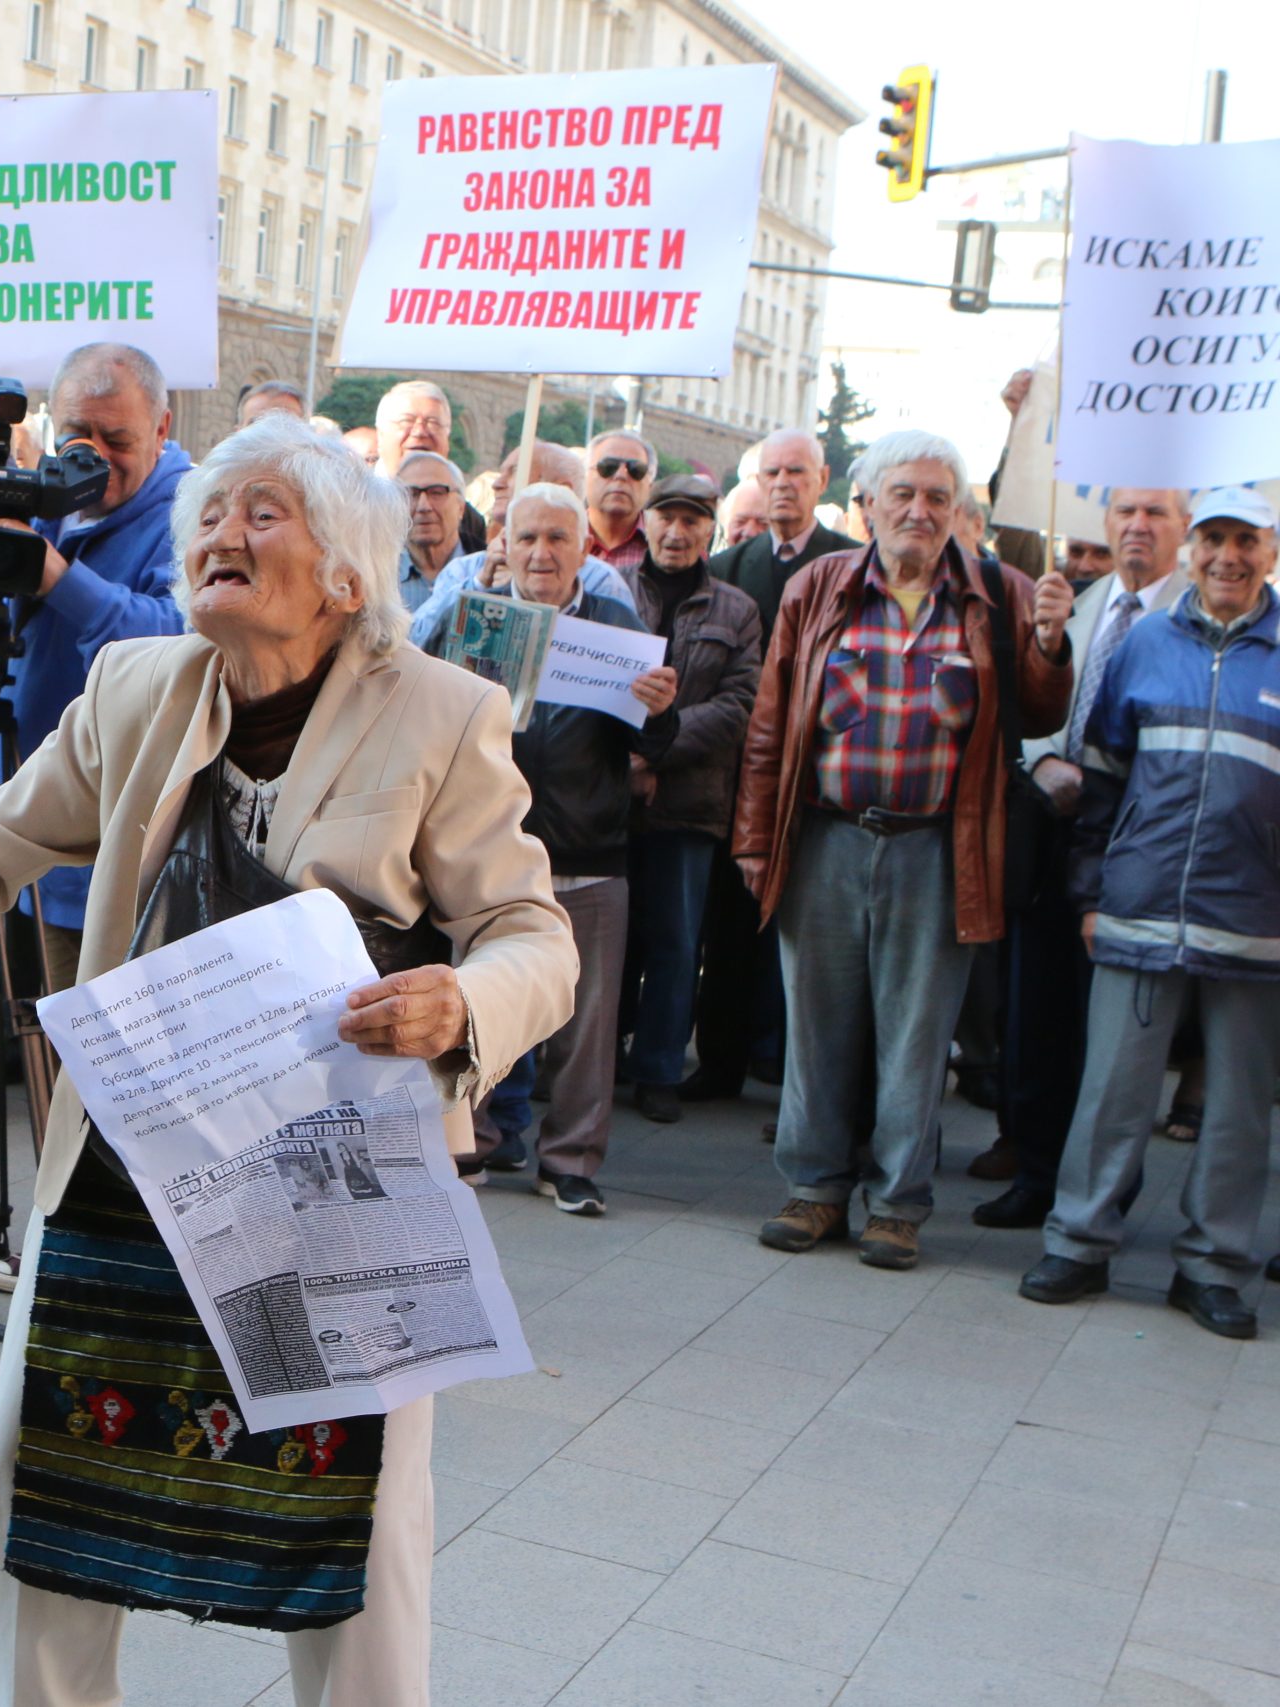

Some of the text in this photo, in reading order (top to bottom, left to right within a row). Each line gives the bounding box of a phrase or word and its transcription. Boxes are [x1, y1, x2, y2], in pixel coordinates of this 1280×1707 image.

[416, 103, 723, 154] РАВЕНСТВО ПРЕД
[463, 166, 651, 212] ЗАКОНА ЗА
[419, 228, 686, 277] ГРАЖДАНИТЕ И
[1083, 234, 1264, 269] ИСКАМЕ
[384, 287, 702, 337] УПРАВЛЯВАЩИТЕ
[1151, 284, 1280, 318] КОИТ
[1131, 333, 1280, 366] ОСИГУ
[1075, 378, 1278, 416] ДОСТОЕН
[550, 639, 651, 673] РЕИЗЧИСЛЕТЕ
[71, 951, 234, 1030] Депутатите 160 в парламента
[80, 958, 284, 1049] Искаме магазини за пенсионерите с
[90, 1021, 187, 1067] хранителни стоки
[101, 981, 347, 1087] Субсидиите за депутатите от 12лв. да станат
[111, 1092, 126, 1103] на
[127, 1086, 150, 1099] 2лв.
[151, 1067, 195, 1092] Другите
[195, 1059, 211, 1072] 10
[219, 1051, 233, 1062] за
[234, 1014, 313, 1054] пенсионерите
[122, 1061, 259, 1125] Депутатите до 2 мандата
[134, 1041, 340, 1138] Който иска да го избират да си плаща
[336, 1107, 362, 1119] НА
[292, 1121, 363, 1138] метлата
[167, 1174, 214, 1201] пред
[212, 1141, 314, 1181] парламента
[304, 1259, 469, 1286] 100% ТИБЕТСКА МЕДИЦИНА
